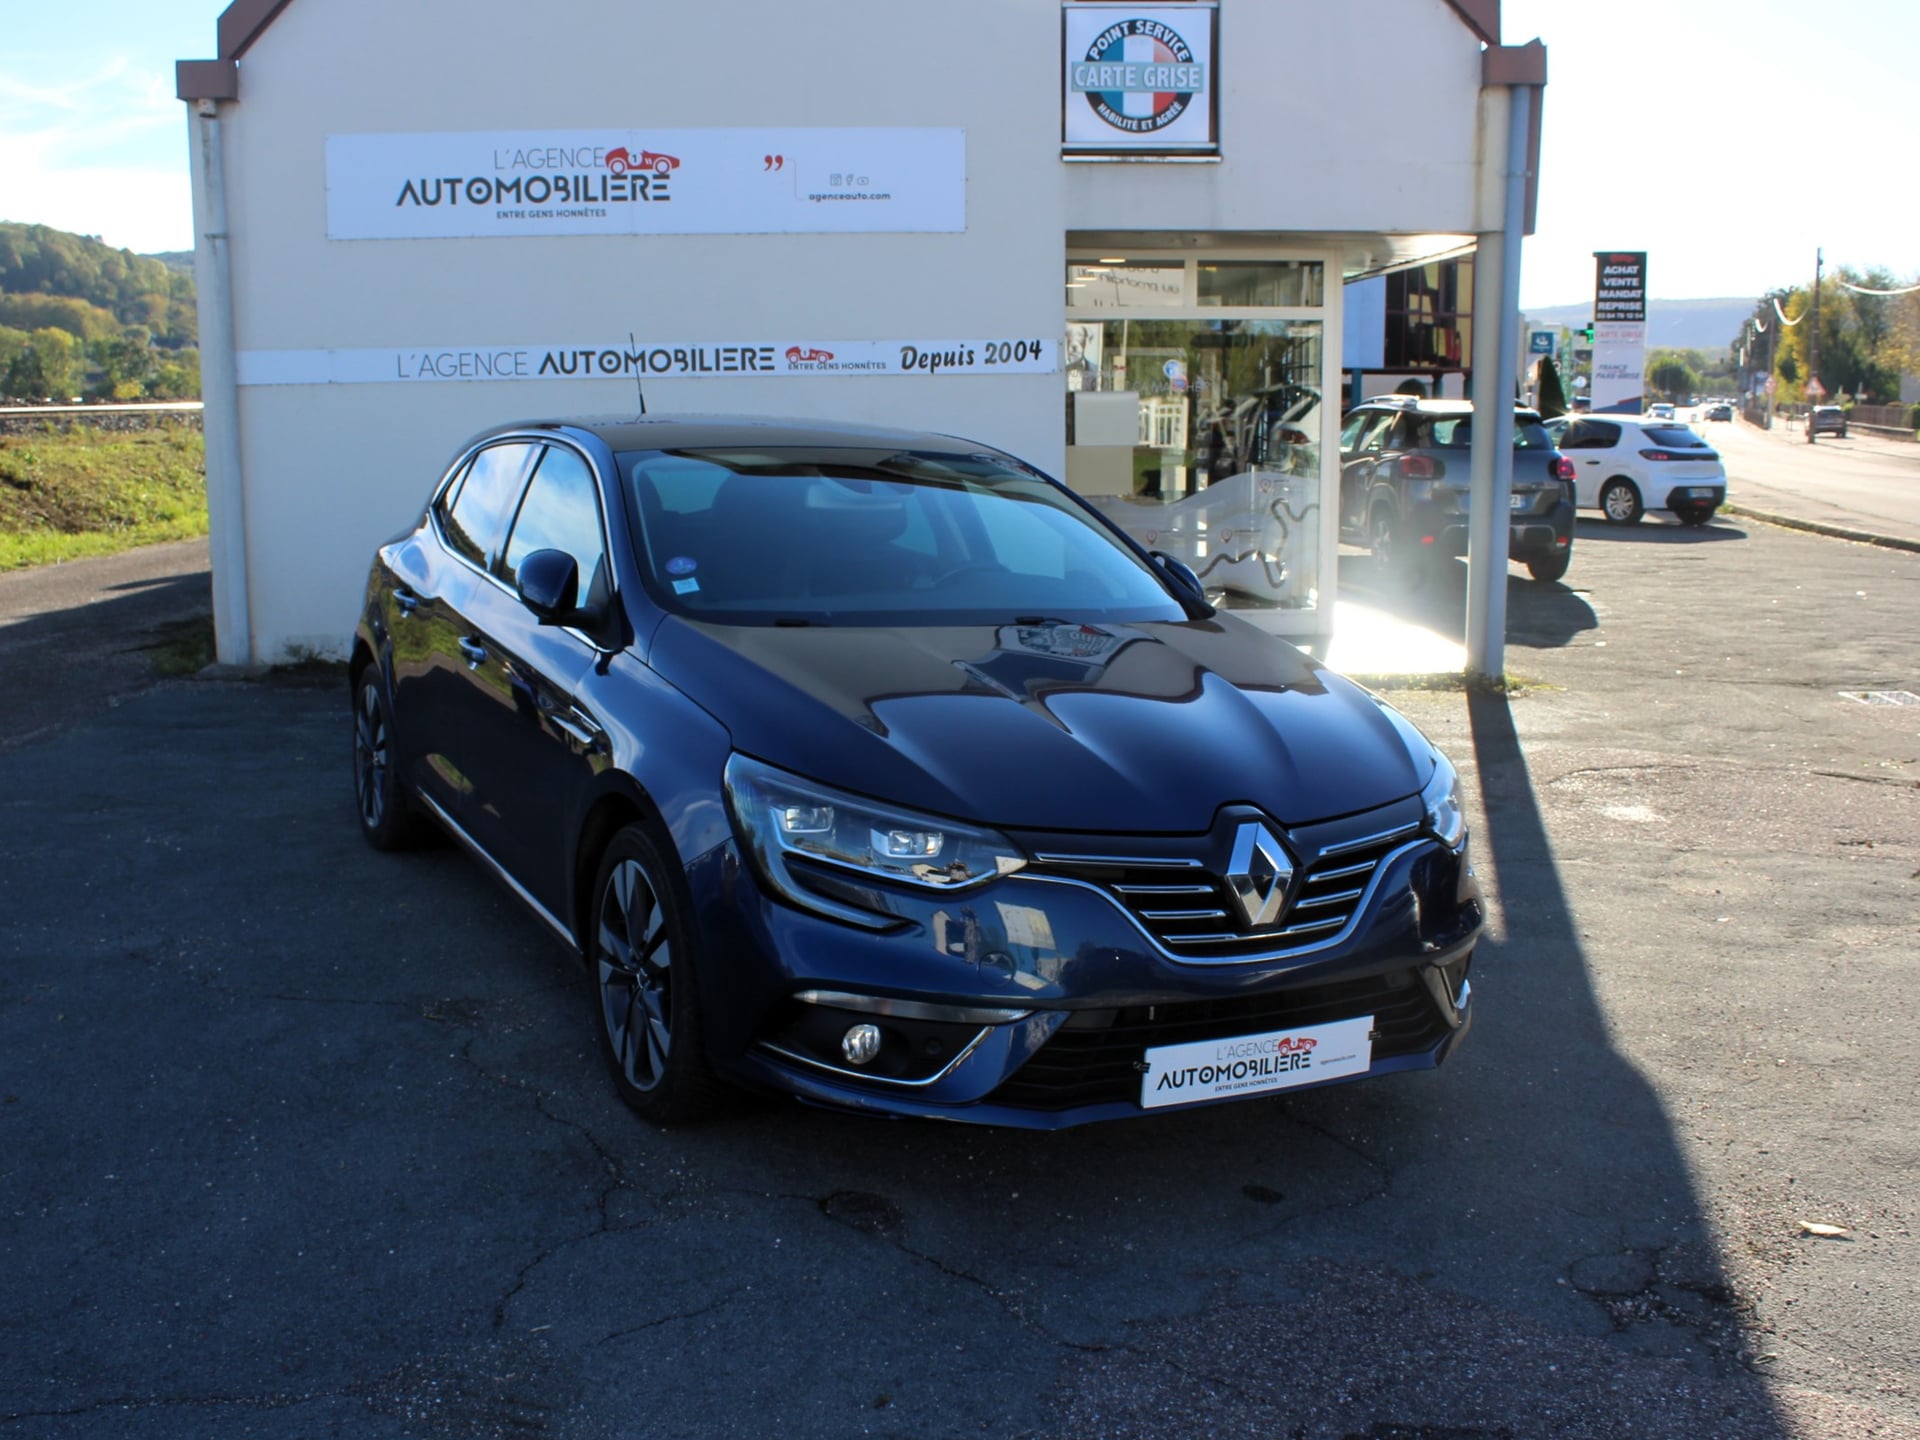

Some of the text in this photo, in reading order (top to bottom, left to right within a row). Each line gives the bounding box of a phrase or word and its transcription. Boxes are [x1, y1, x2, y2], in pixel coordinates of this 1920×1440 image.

[1089, 20, 1190, 62] POINT SERVICE
[1075, 65, 1200, 88] CARTE GRISE
[1140, 118, 1153, 131] ET
[494, 147, 605, 170] L'AGENCE
[808, 191, 891, 203] agenceauto.com
[496, 210, 526, 220] ENTRE
[528, 209, 555, 219] GENS
[1603, 265, 1640, 275] ACHAT
[1603, 277, 1640, 287] VENTE
[1598, 289, 1644, 299] MANDAT
[1597, 301, 1643, 311] REPRISE
[396, 351, 529, 379] L'AGENCE
[787, 362, 815, 370] ENTRE
[816, 362, 840, 371] GENS
[900, 343, 975, 375] Depuis
[984, 339, 1042, 365] 2004
[1216, 1038, 1278, 1061] L'AGENCE
